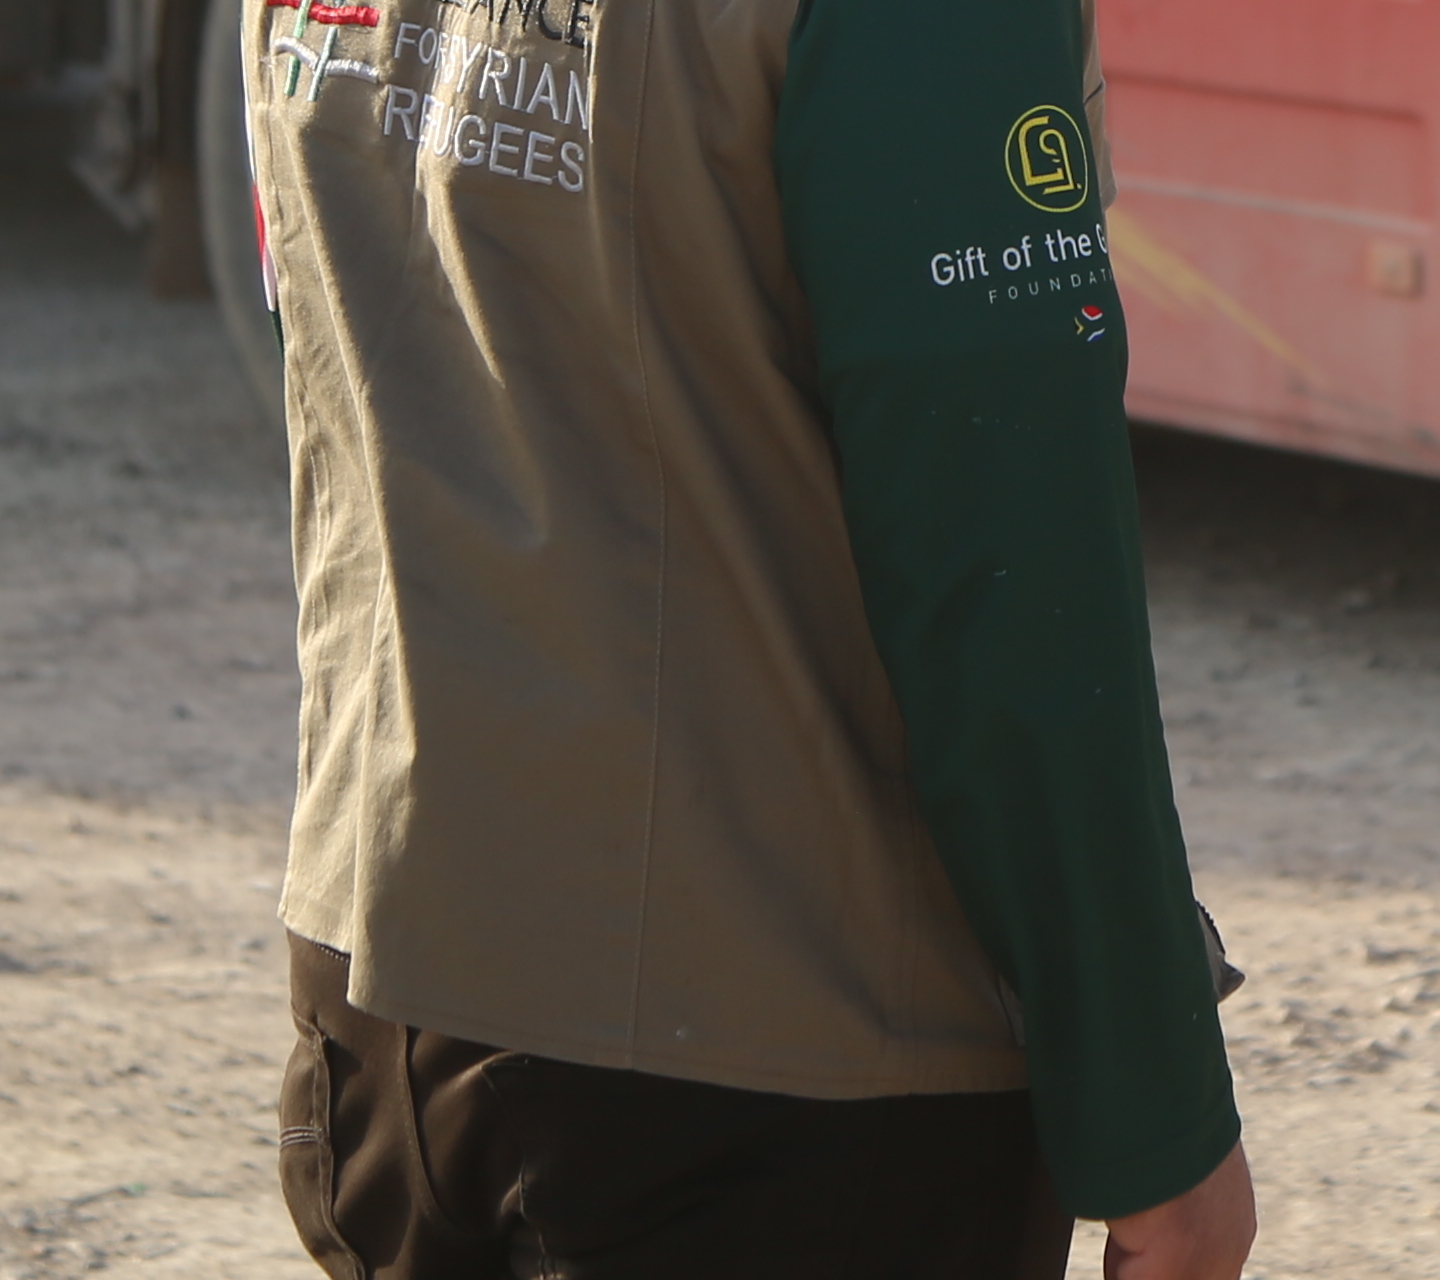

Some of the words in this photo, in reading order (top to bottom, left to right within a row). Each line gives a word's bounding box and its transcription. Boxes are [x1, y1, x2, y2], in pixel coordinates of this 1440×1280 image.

[930, 245, 990, 287] Gift
[1001, 234, 1033, 271] of
[1044, 228, 1093, 263] the
